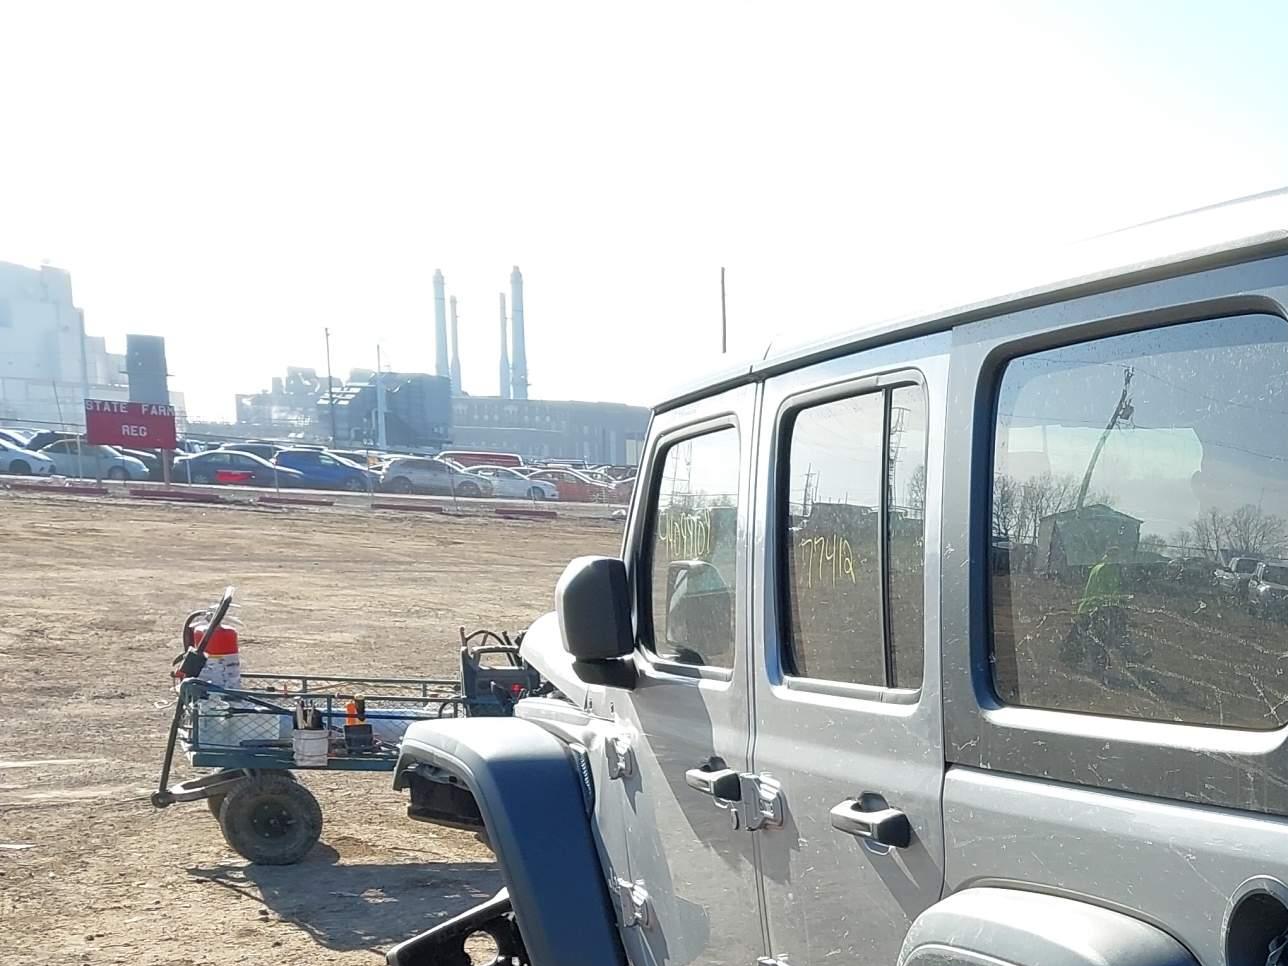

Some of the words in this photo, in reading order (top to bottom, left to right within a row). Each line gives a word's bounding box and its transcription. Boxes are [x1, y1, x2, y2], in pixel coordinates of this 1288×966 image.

[85, 400, 129, 413] STATE
[141, 404, 175, 416] FARM
[121, 424, 148, 437] REG
